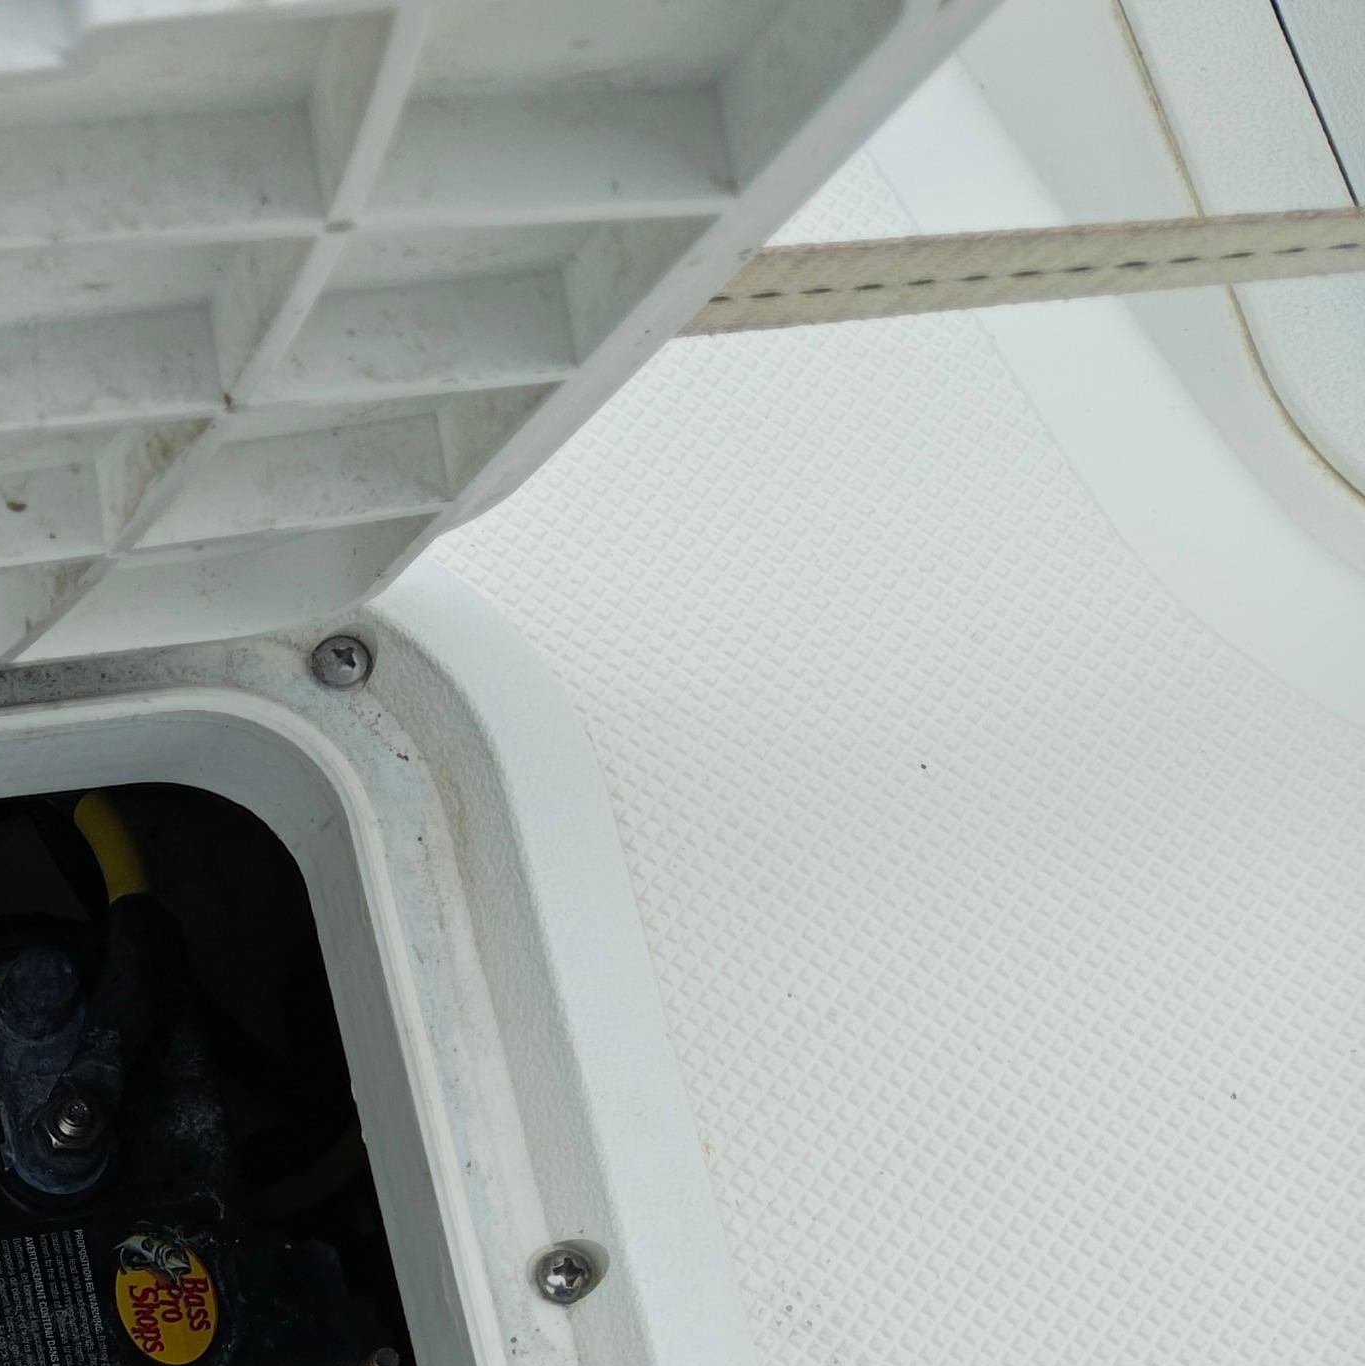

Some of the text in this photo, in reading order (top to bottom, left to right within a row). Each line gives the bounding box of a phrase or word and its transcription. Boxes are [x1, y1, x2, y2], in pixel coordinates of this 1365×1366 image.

[74, 1229, 92, 1280] PROPOSITION
[24, 1236, 46, 1300] AVERTISSEMENT
[38, 1301, 54, 1339] CONTENU
[48, 1340, 60, 1362] DANS
[129, 1285, 165, 1353] Shops
[156, 1284, 183, 1322] Pro
[180, 1277, 211, 1331] Bass
